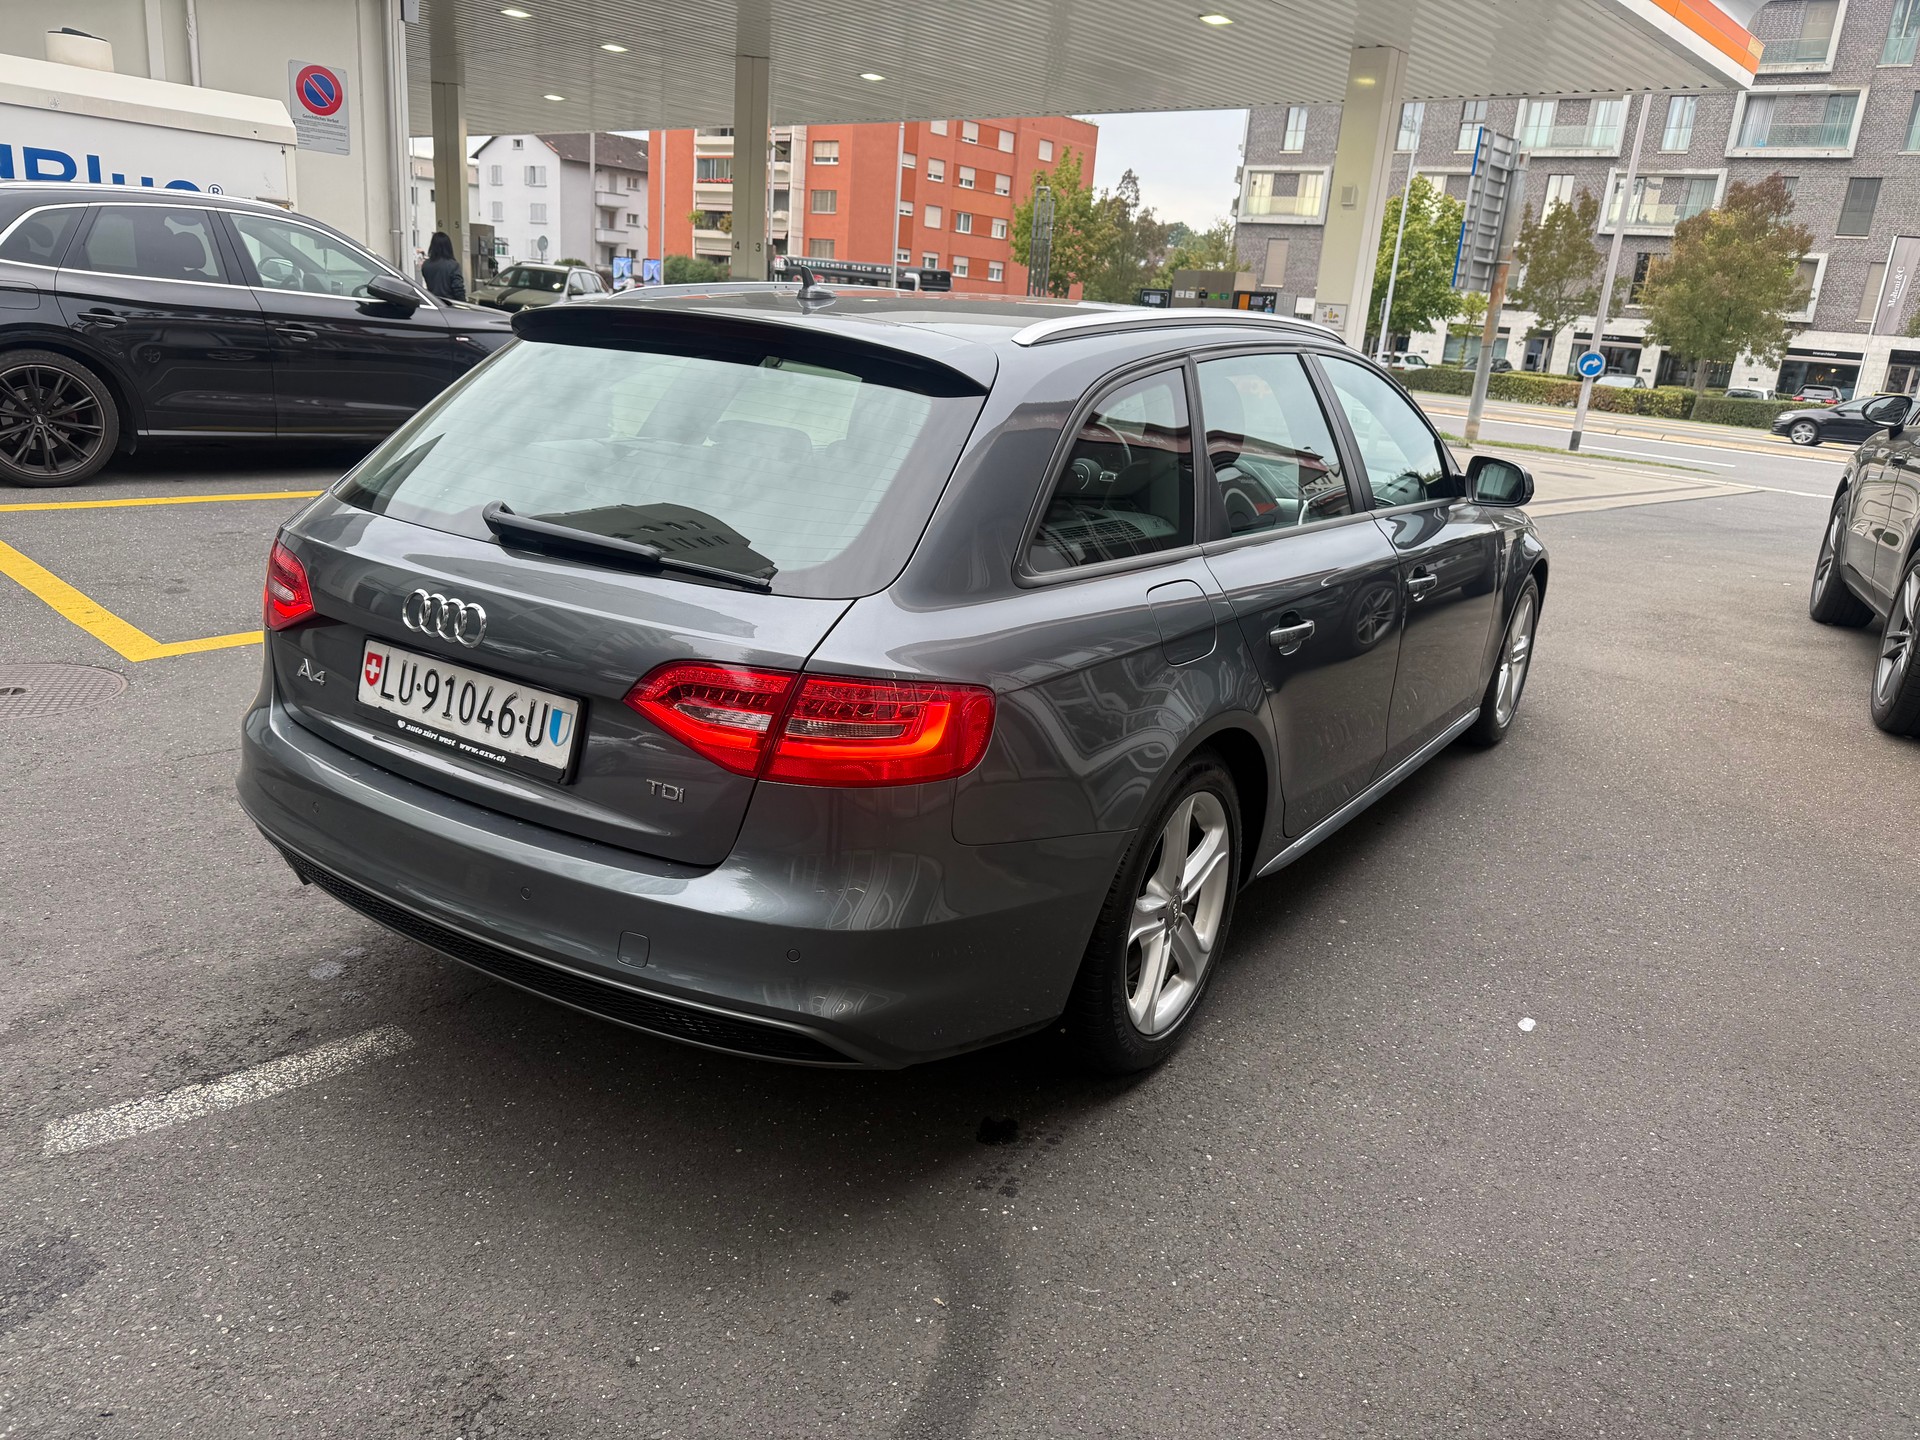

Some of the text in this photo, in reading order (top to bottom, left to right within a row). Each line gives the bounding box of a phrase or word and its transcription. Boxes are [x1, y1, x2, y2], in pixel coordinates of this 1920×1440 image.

[437, 219, 443, 228] 6
[454, 220, 460, 229] 5
[734, 240, 740, 250] 4
[755, 242, 761, 252] 3
[875, 266, 892, 274] MAS
[296, 657, 326, 686] A4
[405, 723, 423, 735] auto
[439, 735, 457, 747] west
